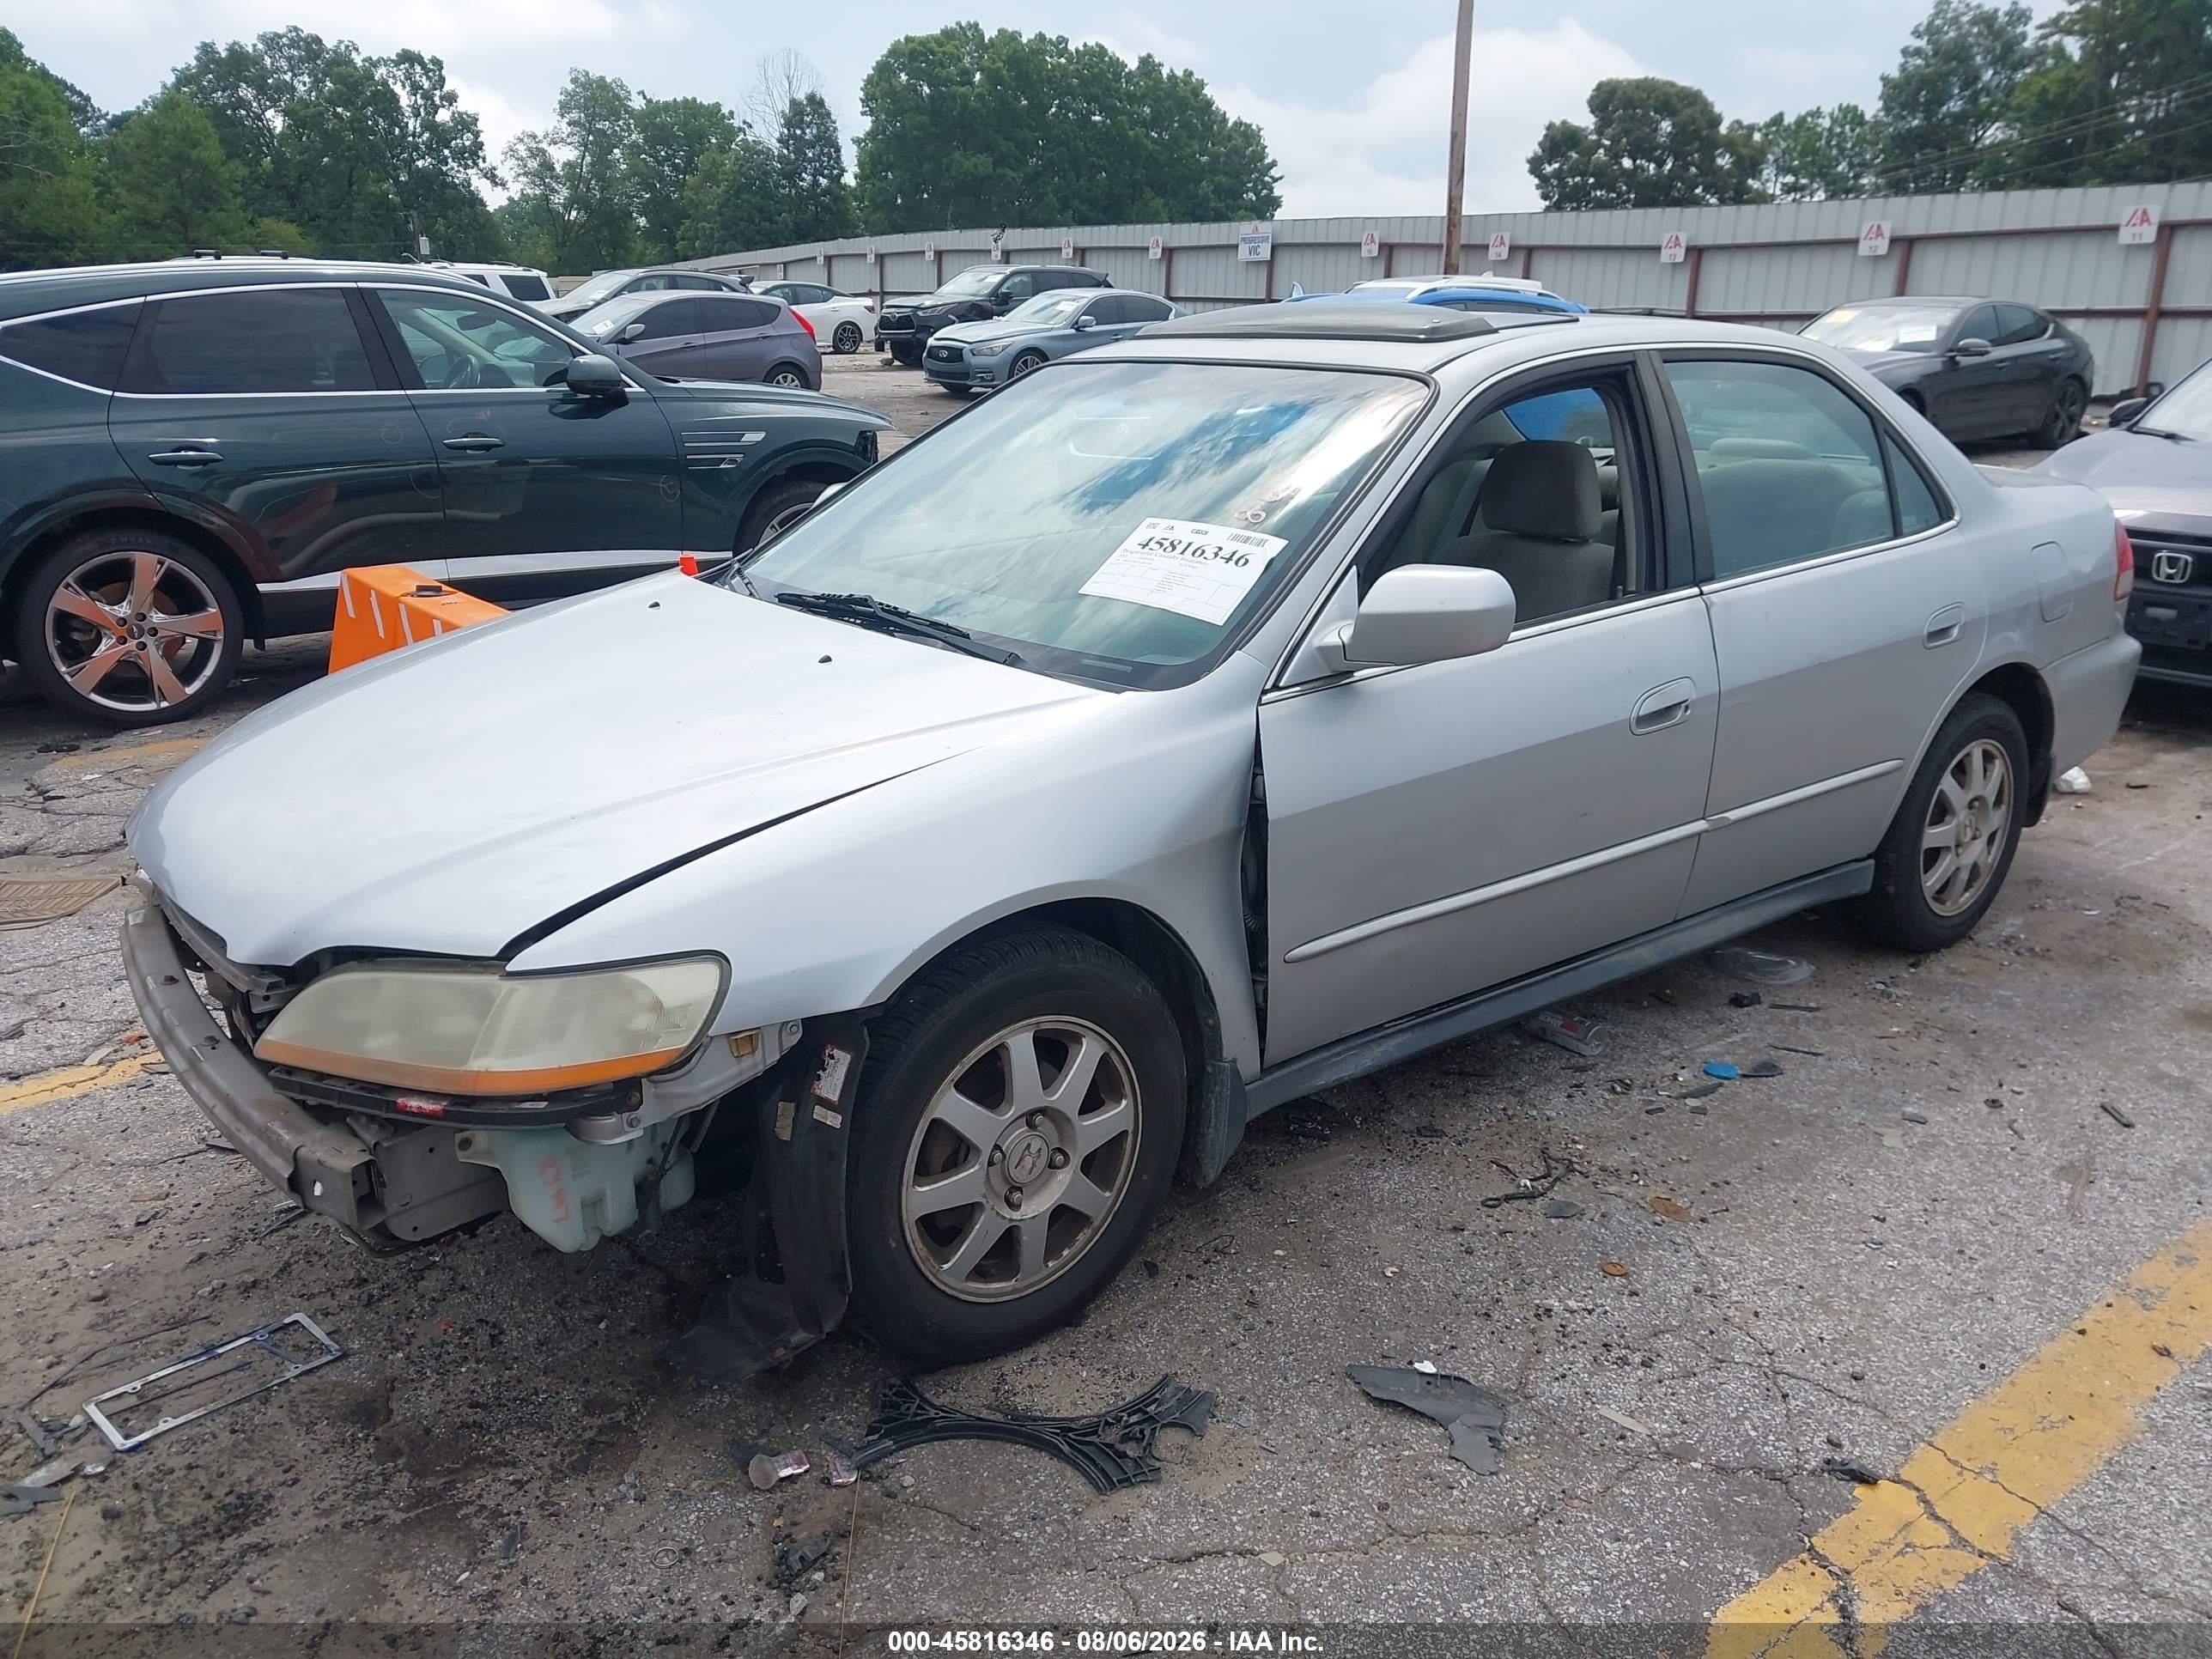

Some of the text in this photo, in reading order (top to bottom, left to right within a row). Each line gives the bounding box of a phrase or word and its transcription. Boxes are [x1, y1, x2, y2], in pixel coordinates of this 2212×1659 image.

[1249, 245, 1261, 256] VIC
[1137, 536, 1255, 568] 45816346
[1155, 552, 1179, 562] Casualty
[1181, 556, 1209, 566] Insurance
